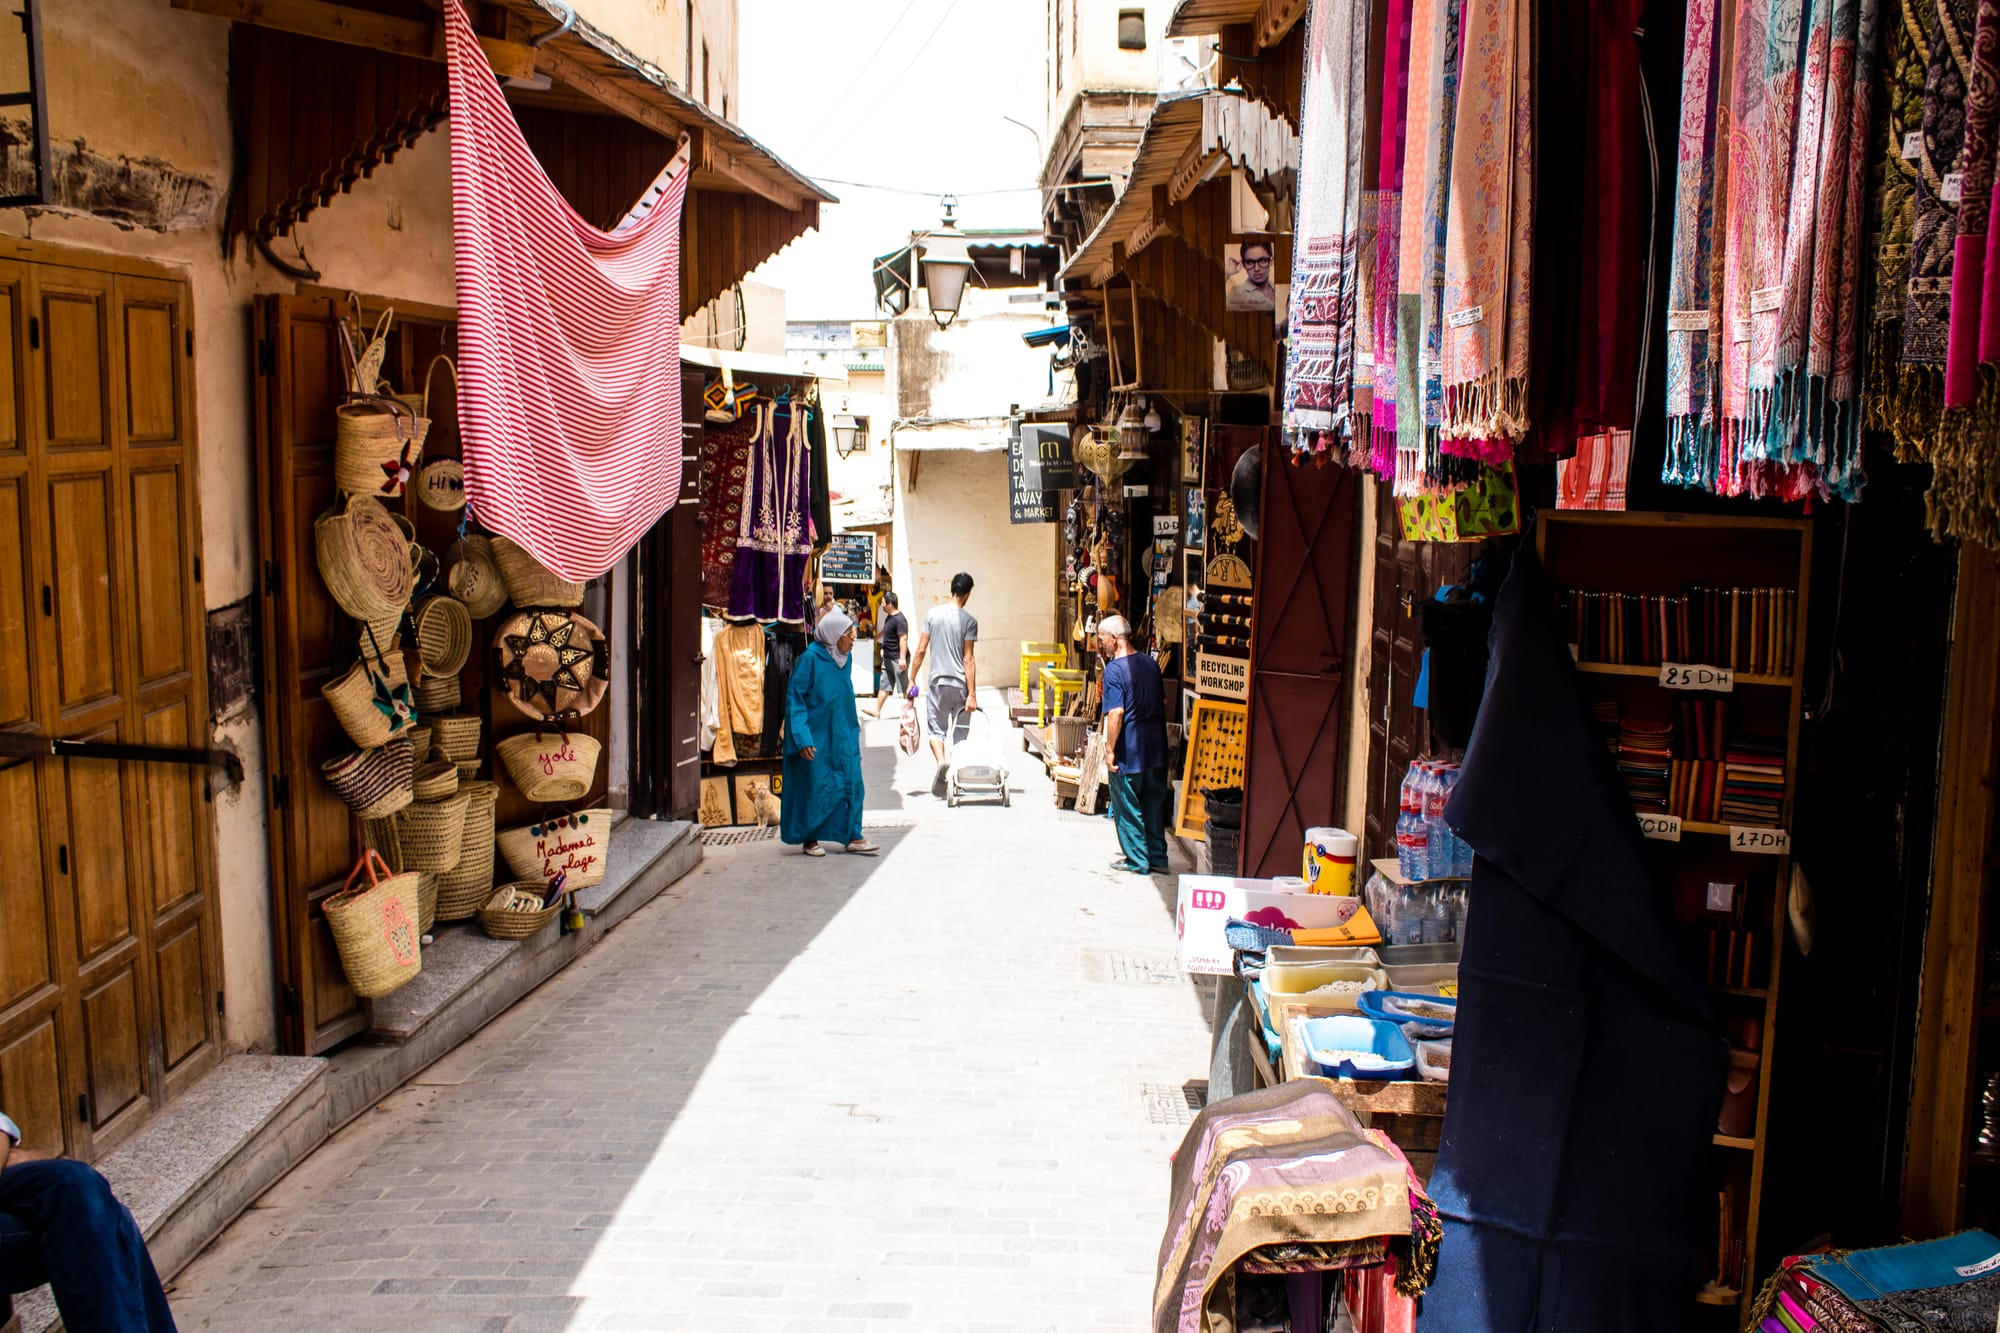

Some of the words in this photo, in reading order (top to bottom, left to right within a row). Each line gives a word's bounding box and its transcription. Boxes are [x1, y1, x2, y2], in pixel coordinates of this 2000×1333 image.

[1012, 442, 1024, 455] EA
[1013, 476, 1025, 489] TA
[1013, 491, 1042, 505] AWAY
[1014, 509, 1022, 519] &
[1024, 507, 1053, 518] MARKET
[1201, 660, 1244, 676] RECYCLING
[1666, 667, 1692, 685] 25
[1698, 669, 1728, 684] DH
[1201, 675, 1244, 692] WORKSHOP
[537, 836, 584, 858] Madame
[543, 859, 557, 877] la
[562, 853, 597, 879] plage
